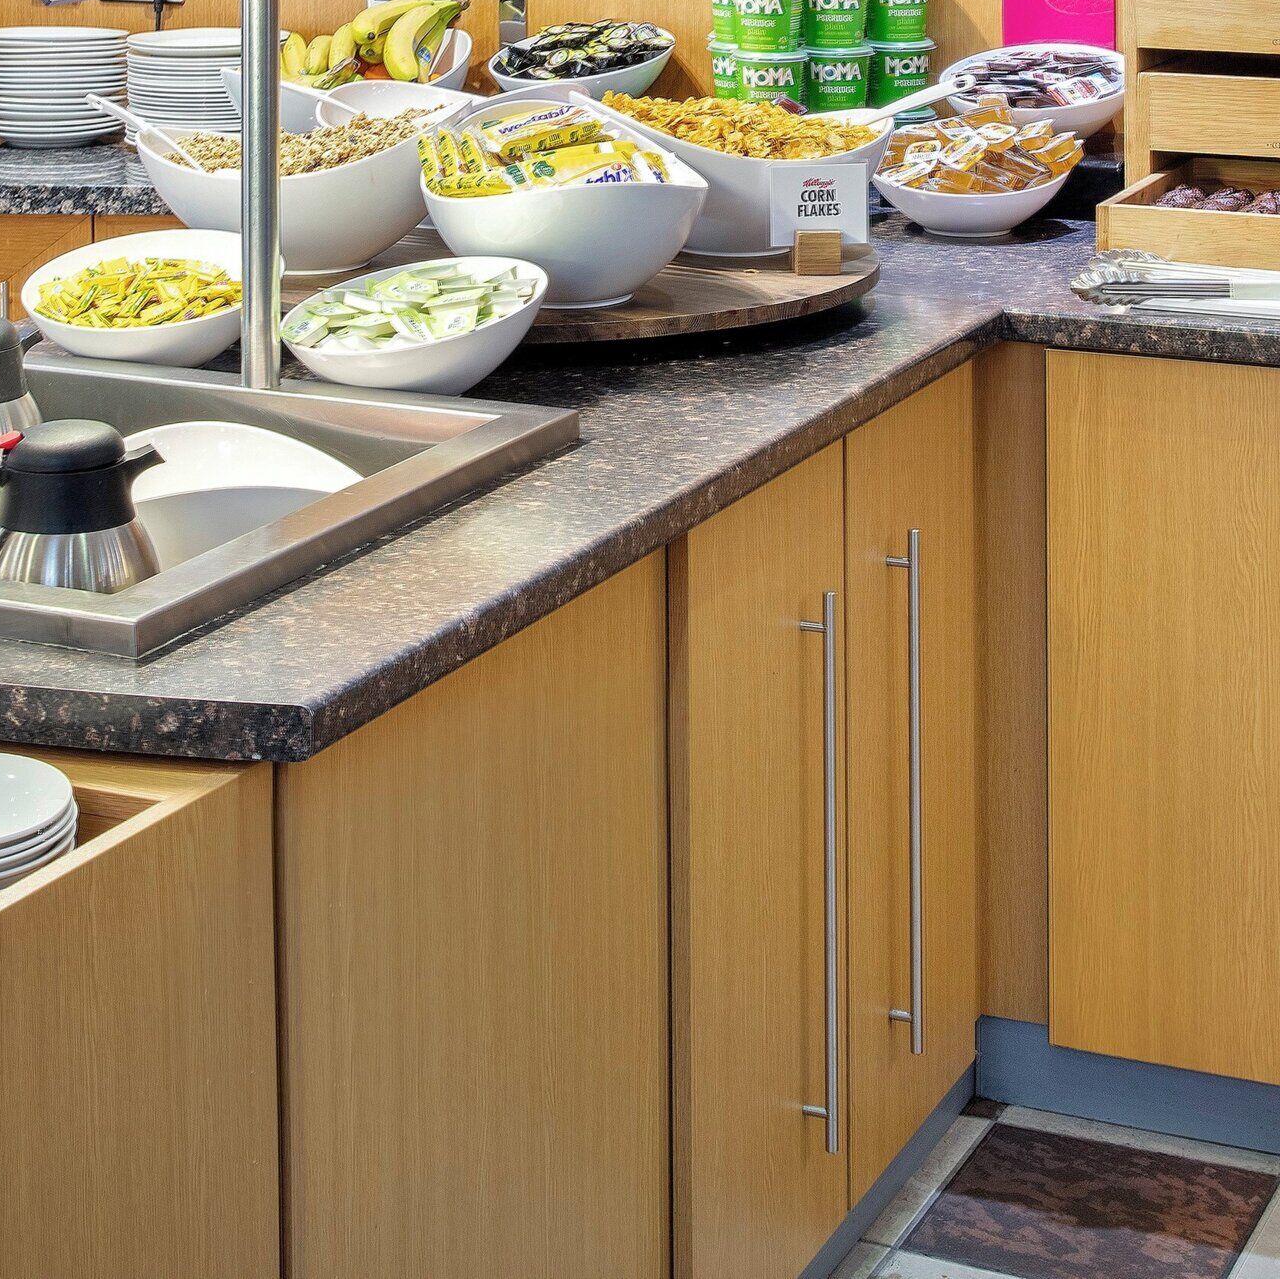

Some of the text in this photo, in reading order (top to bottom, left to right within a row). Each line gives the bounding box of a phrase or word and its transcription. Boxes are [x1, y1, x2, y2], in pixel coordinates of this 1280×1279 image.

[742, 66, 794, 88] MOMA
[811, 61, 861, 83] MOMA
[884, 55, 929, 77] MOMA
[800, 189, 837, 202] CORN
[797, 203, 841, 217] FLAKES
